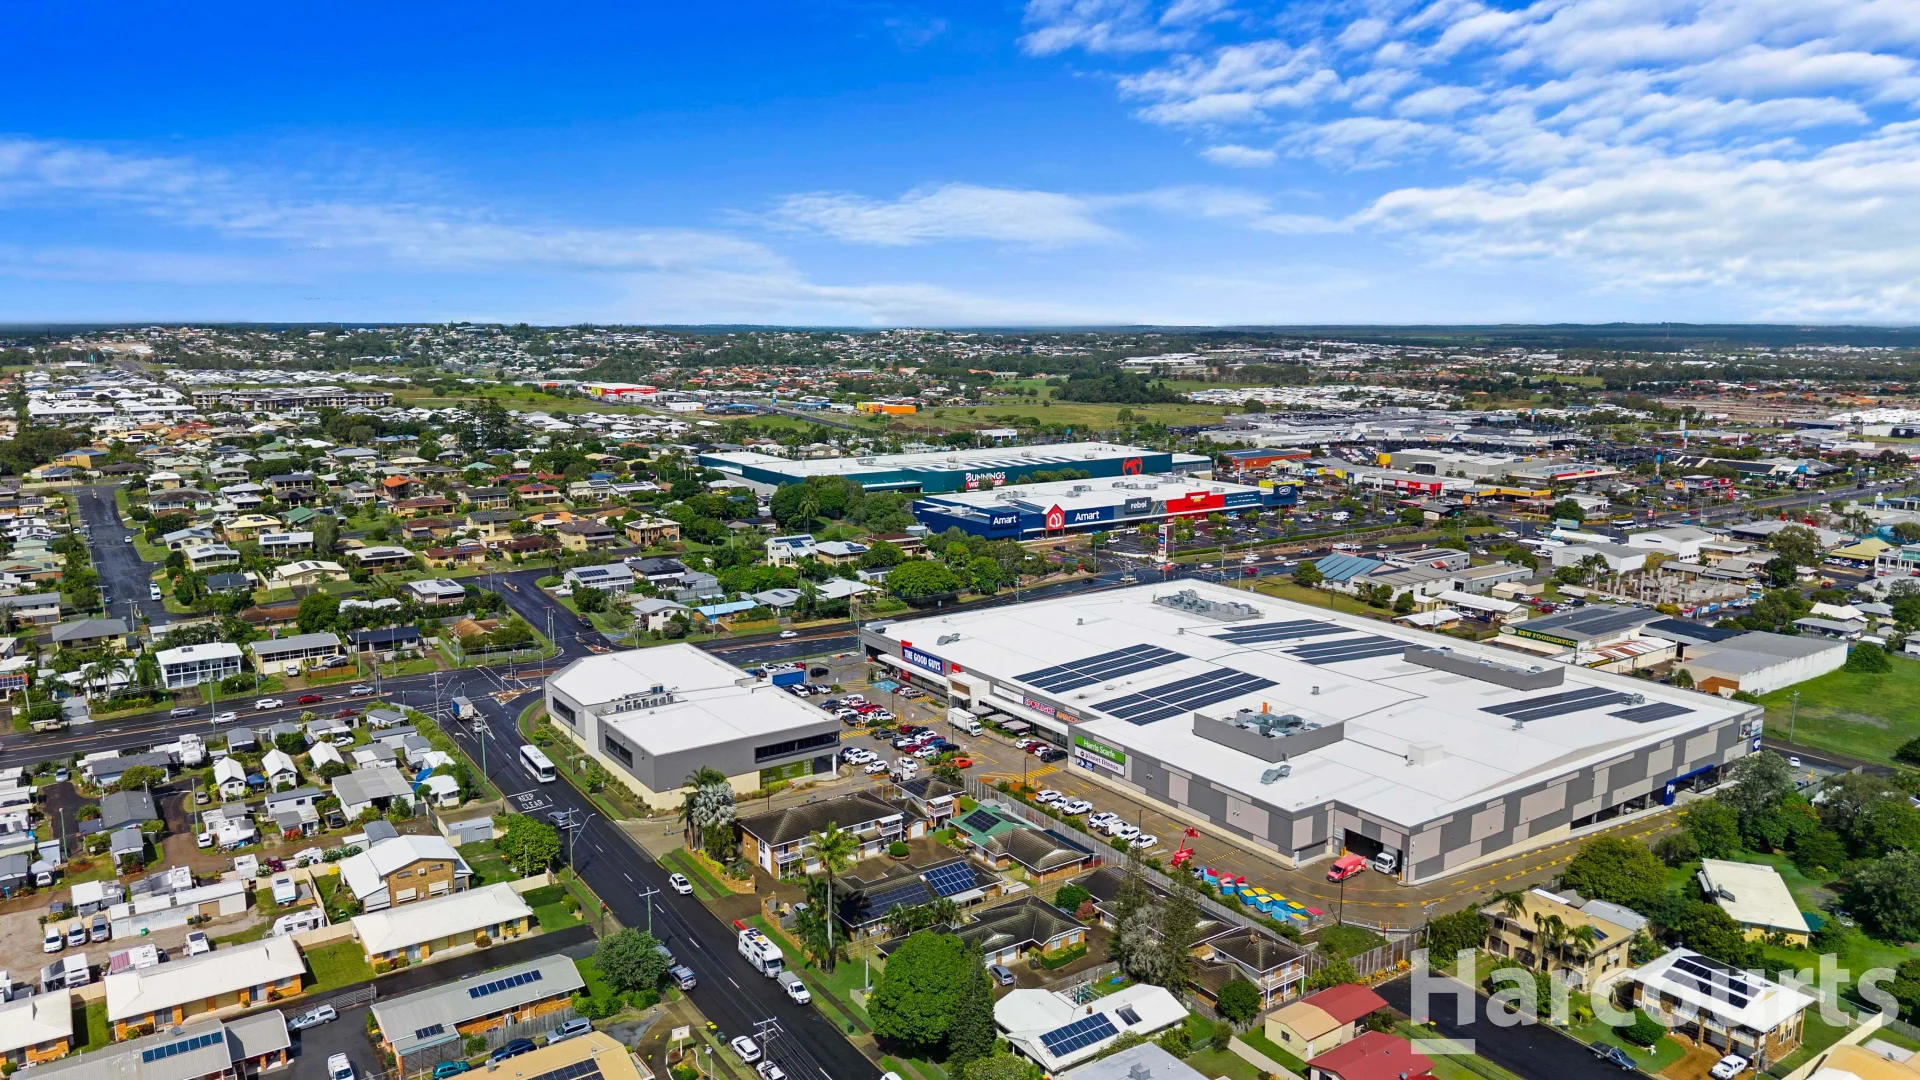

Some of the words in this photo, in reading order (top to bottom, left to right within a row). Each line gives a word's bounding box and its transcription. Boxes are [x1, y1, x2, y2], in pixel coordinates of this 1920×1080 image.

[966, 472, 1006, 482] BUNNINGS
[1130, 500, 1147, 511] rebel
[993, 515, 1017, 526] Amart
[1074, 510, 1100, 522] Amart
[904, 649, 913, 660] THE
[913, 653, 928, 665] GOOD
[928, 658, 941, 671] GUYS
[1025, 697, 1056, 716] SPOTLIGHT
[1083, 739, 1099, 752] Harris
[1099, 747, 1116, 759] Scarfe
[1085, 752, 1101, 764] planet
[1101, 758, 1119, 771] fitness
[517, 793, 534, 803] KEEP
[521, 800, 544, 810] CLEAR
